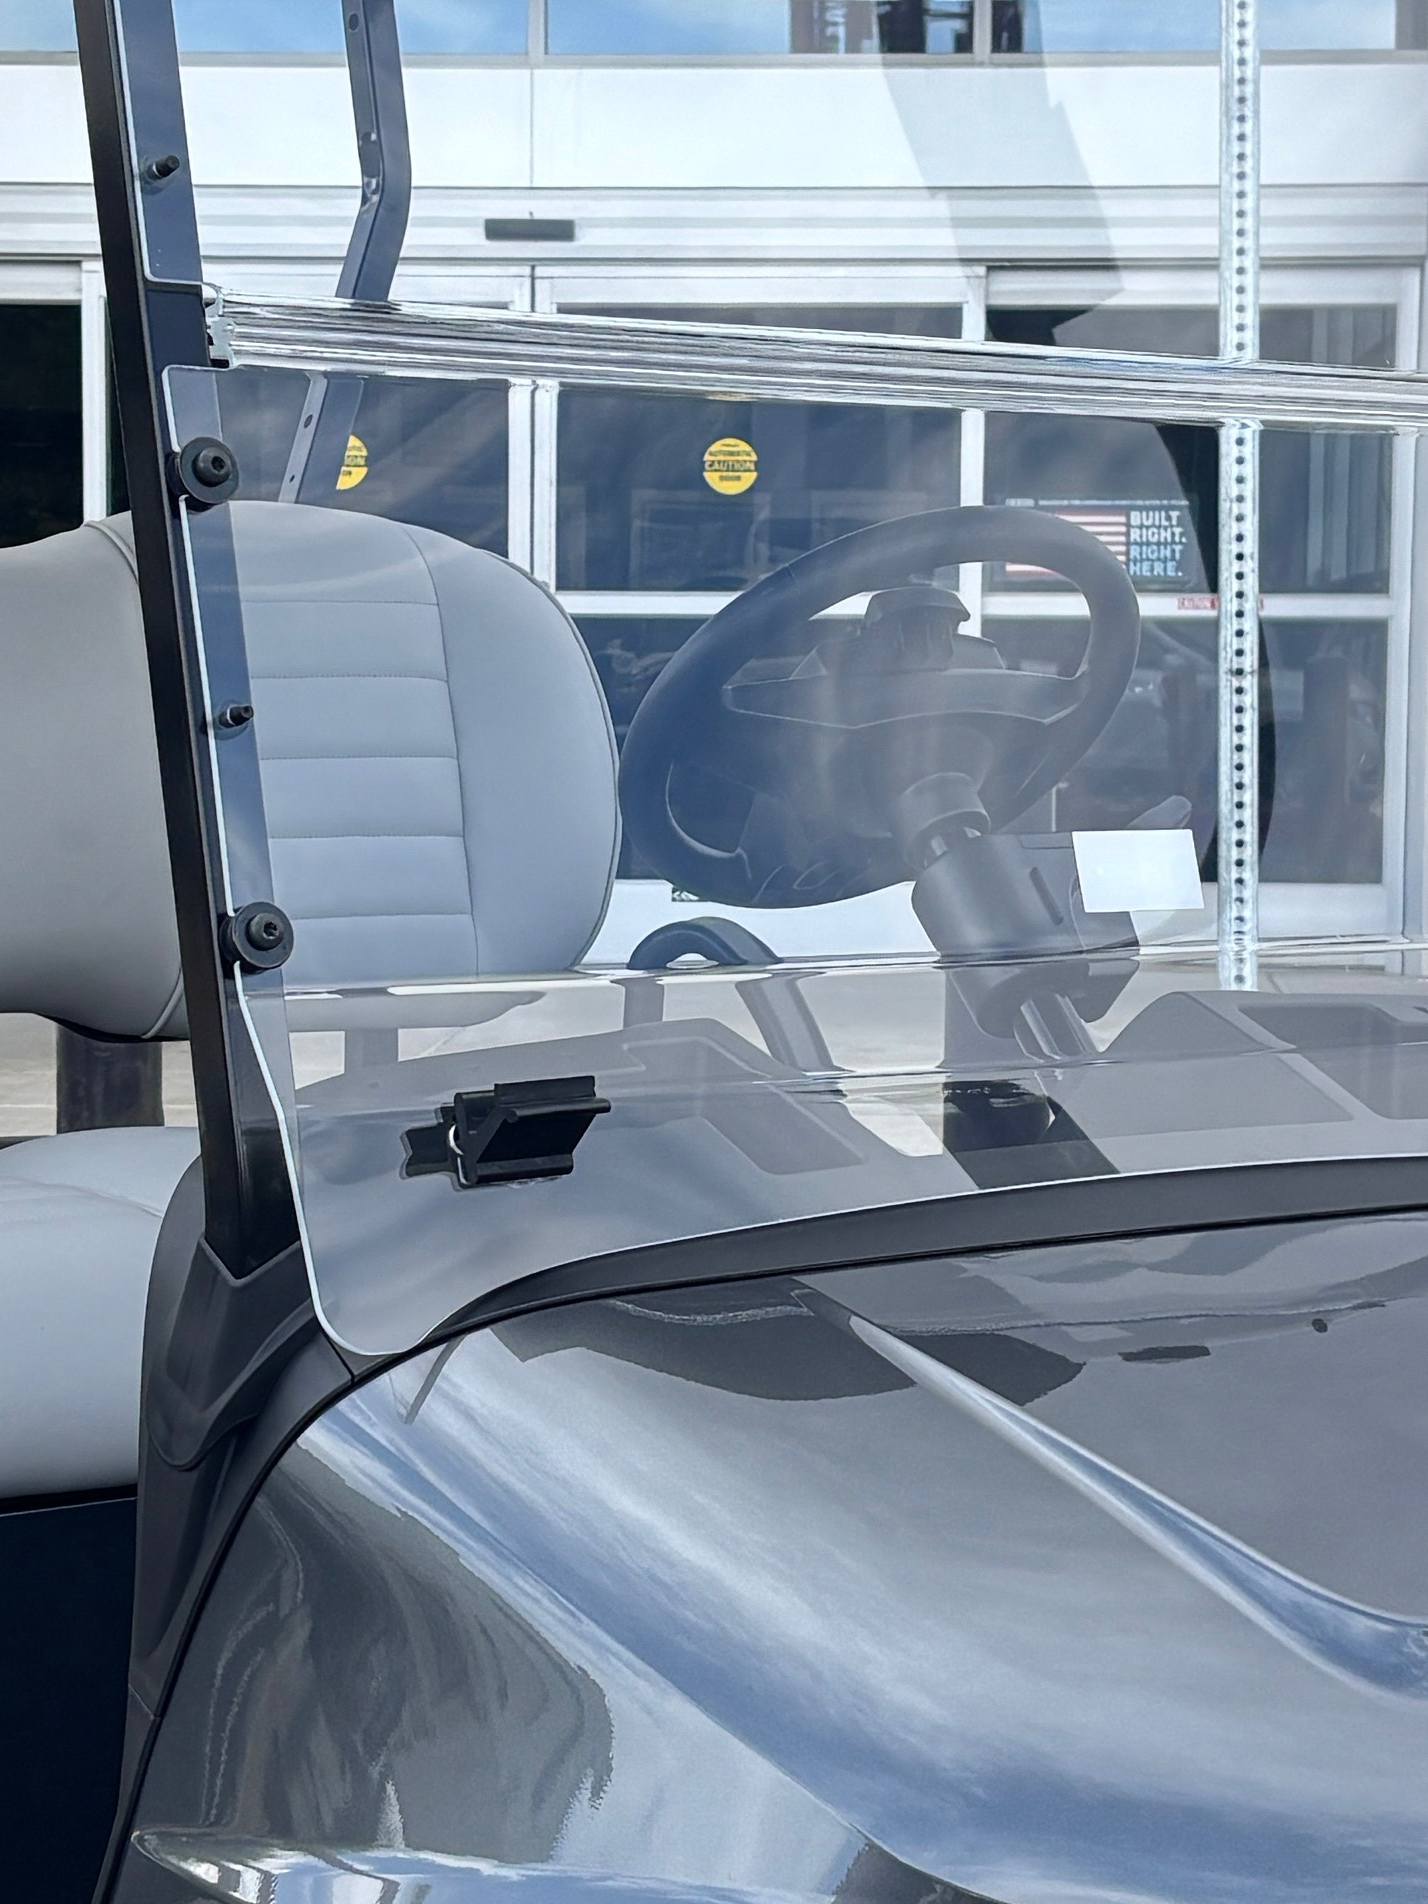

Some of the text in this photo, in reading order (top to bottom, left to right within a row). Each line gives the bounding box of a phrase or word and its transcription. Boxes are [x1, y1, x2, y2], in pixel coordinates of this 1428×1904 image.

[1129, 510, 1181, 527] BUILT
[1129, 527, 1188, 544] RIGHT.
[1128, 544, 1185, 561] RIGHT
[1128, 560, 1183, 577] HERE.
